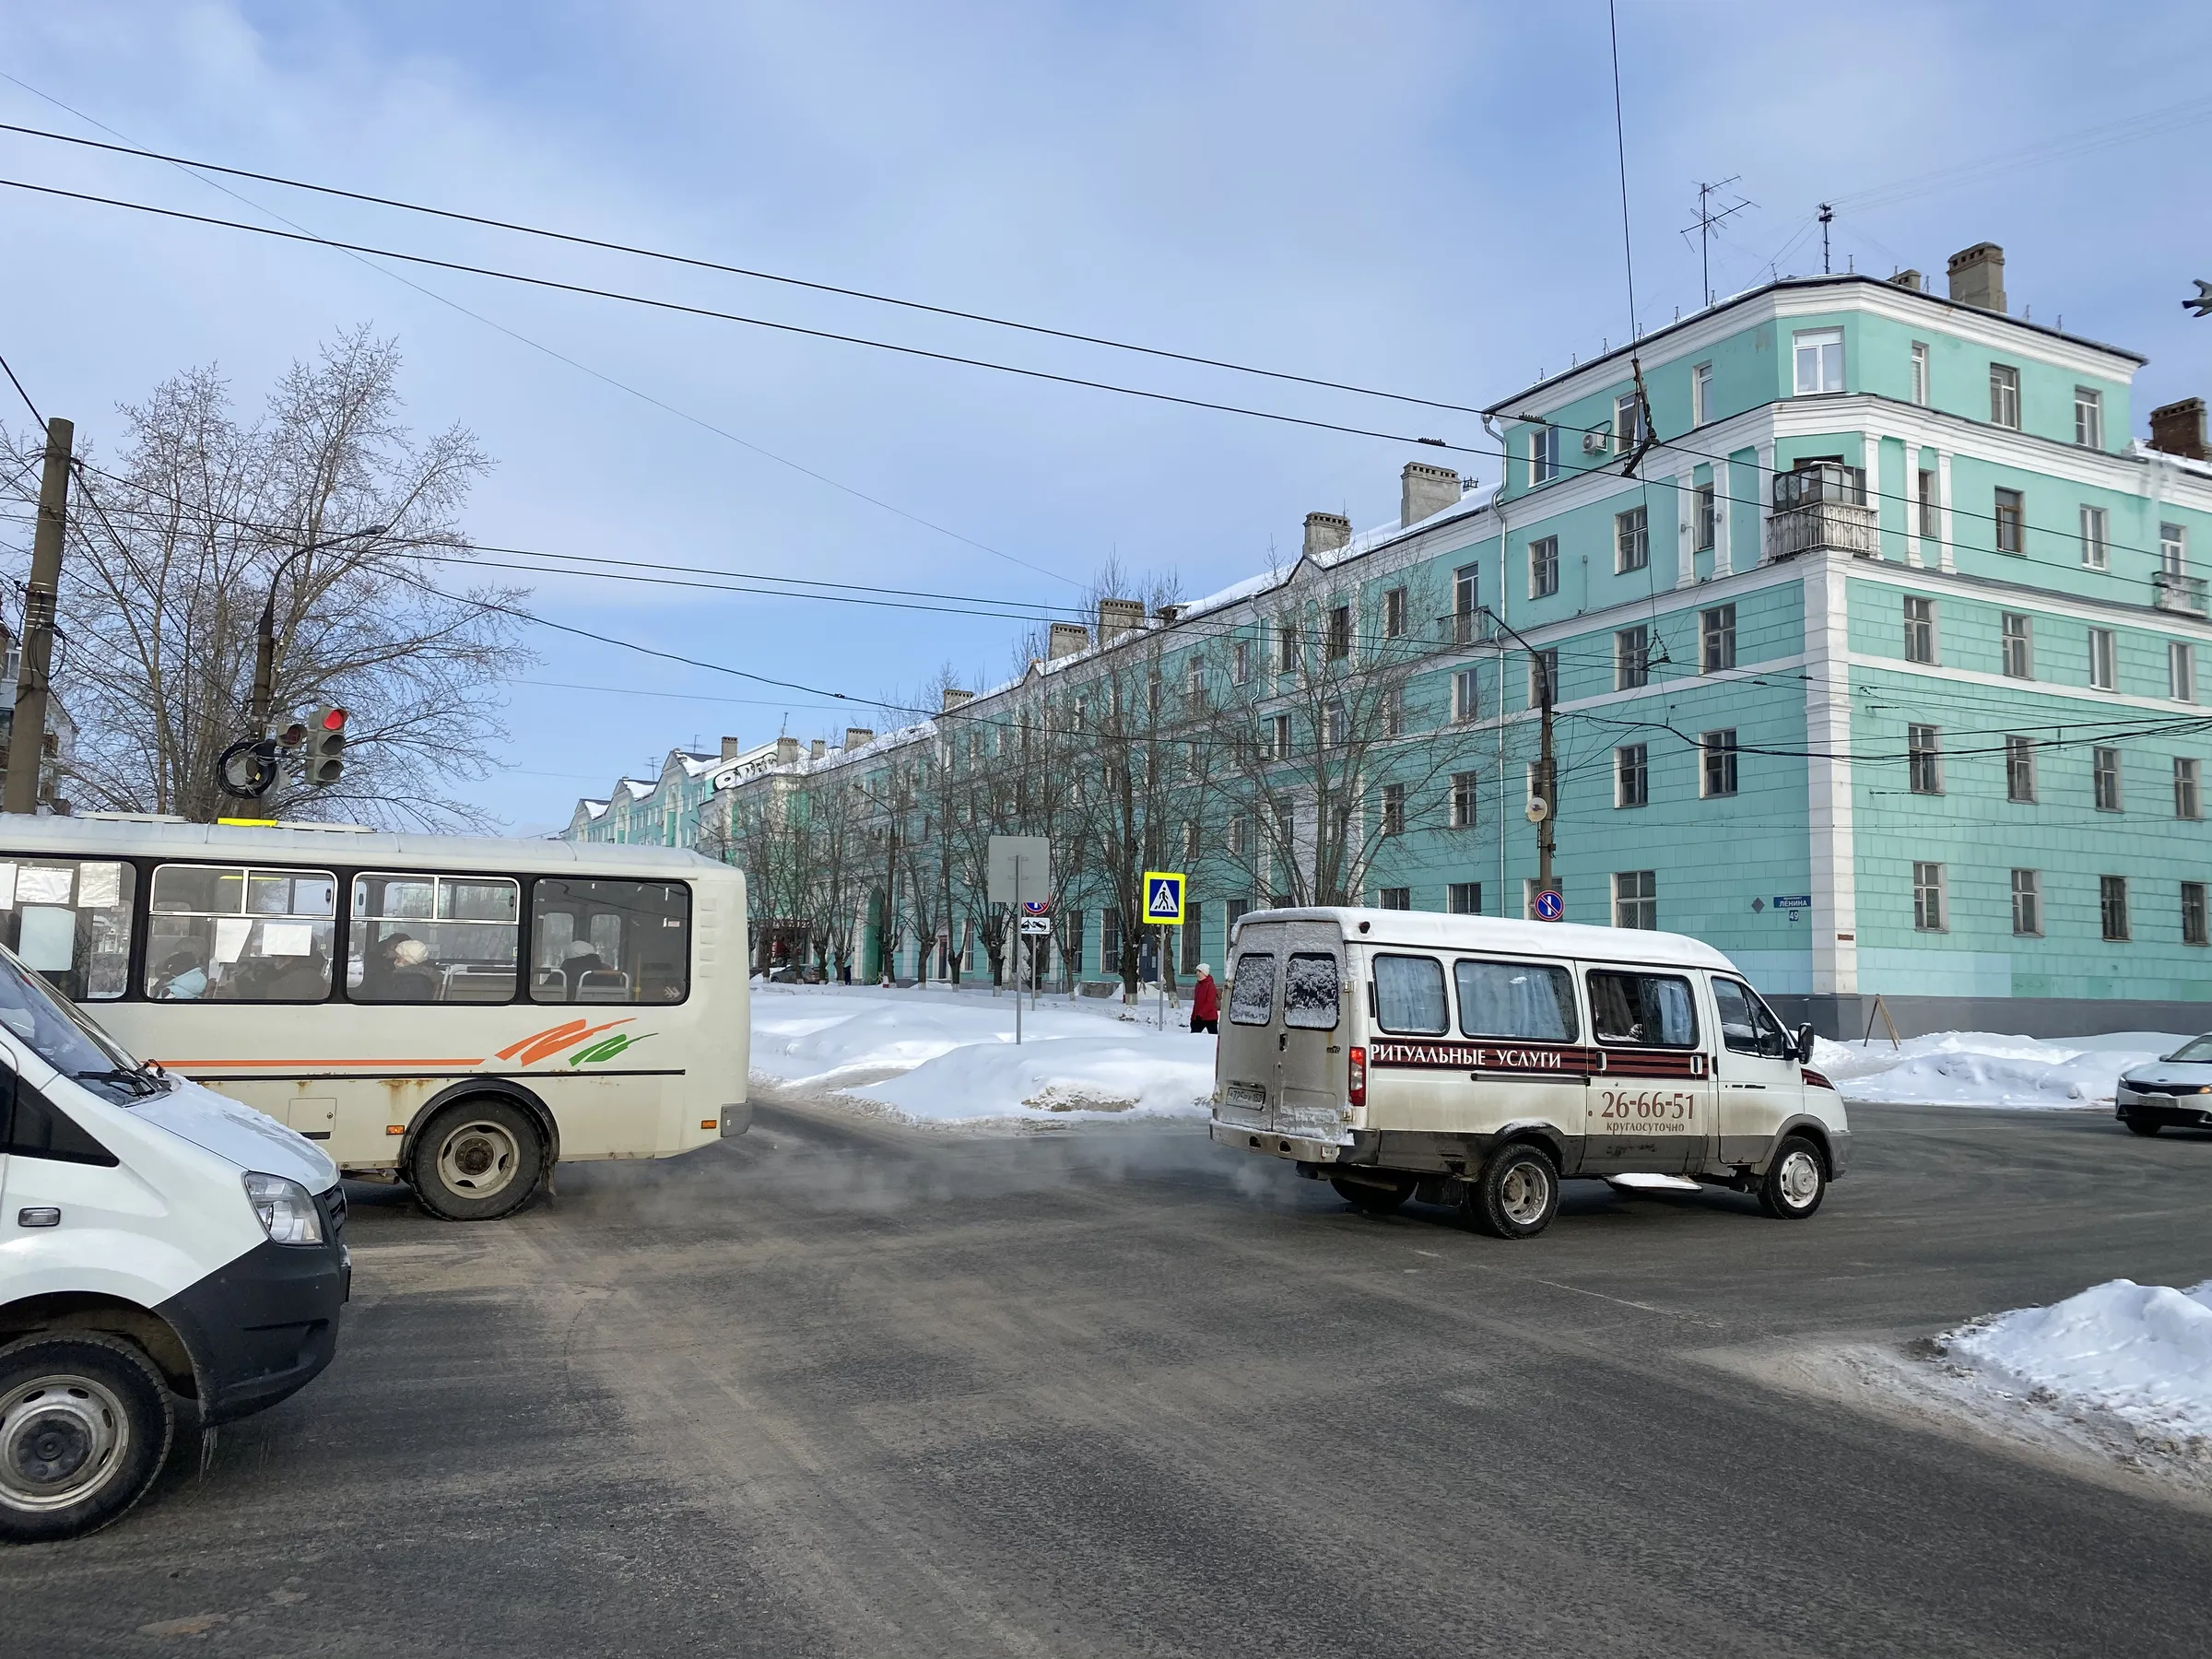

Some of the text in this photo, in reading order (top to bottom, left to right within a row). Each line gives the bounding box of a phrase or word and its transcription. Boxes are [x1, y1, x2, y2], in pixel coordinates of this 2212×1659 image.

[1789, 912, 1798, 920] 49
[1371, 1044, 1561, 1068] РИТУАЛЬНЫЕ УСЛУГИ
[1601, 1091, 1694, 1120] 26-66-51
[1606, 1122, 1685, 1135] круглосуточно
